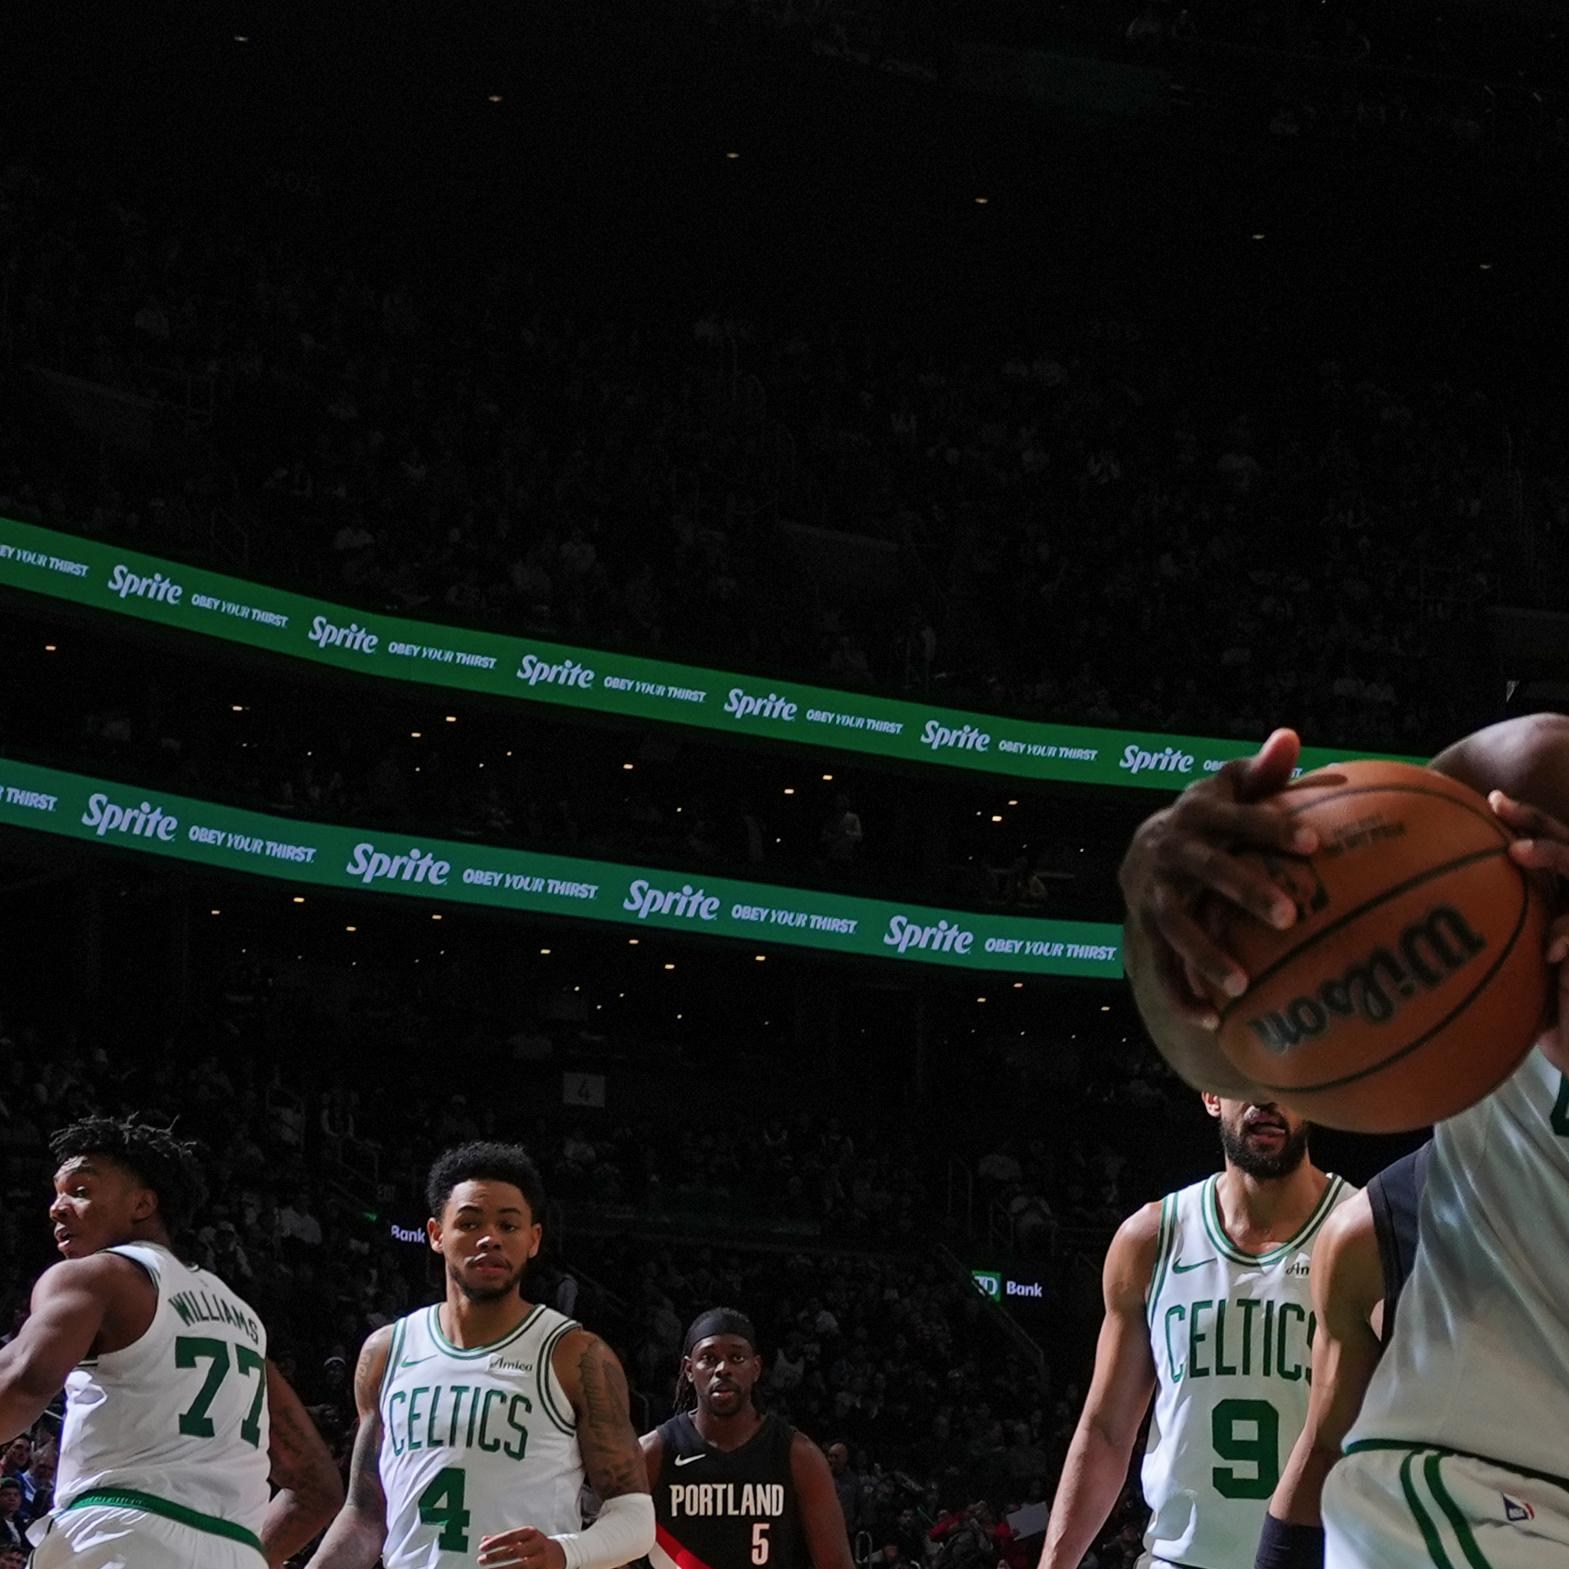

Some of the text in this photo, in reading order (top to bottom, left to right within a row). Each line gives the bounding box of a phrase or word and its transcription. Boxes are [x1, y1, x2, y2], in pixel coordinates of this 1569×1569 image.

[107, 564, 183, 604] Sprite
[308, 615, 379, 654] Sprite
[516, 654, 595, 689] Sprite
[723, 688, 798, 721] Sprite
[920, 720, 991, 752] Sprite
[1119, 745, 1194, 774] Sprite
[5, 787, 59, 811] THIRST
[81, 793, 317, 862] Sprite OBEY YOUR THIRST
[346, 843, 599, 899] Sprite OBEY YOUR THIRST
[623, 879, 858, 934] Sprite OBEY YOUR THIRST
[883, 915, 1117, 960] Sprite OBEY YOUR THIRST
[1251, 904, 1487, 1056] Wilson
[390, 1223, 427, 1245] Bank
[1005, 1279, 1044, 1299] Bank
[168, 1290, 259, 1345] WILLIAMS
[488, 1356, 534, 1374] Amica
[174, 1335, 267, 1450] 77
[388, 1385, 533, 1462] CELTICS
[1211, 1398, 1280, 1500] 9
[418, 1466, 471, 1554] 4
[668, 1483, 785, 1517] PORTLAND
[751, 1522, 771, 1566] 5
